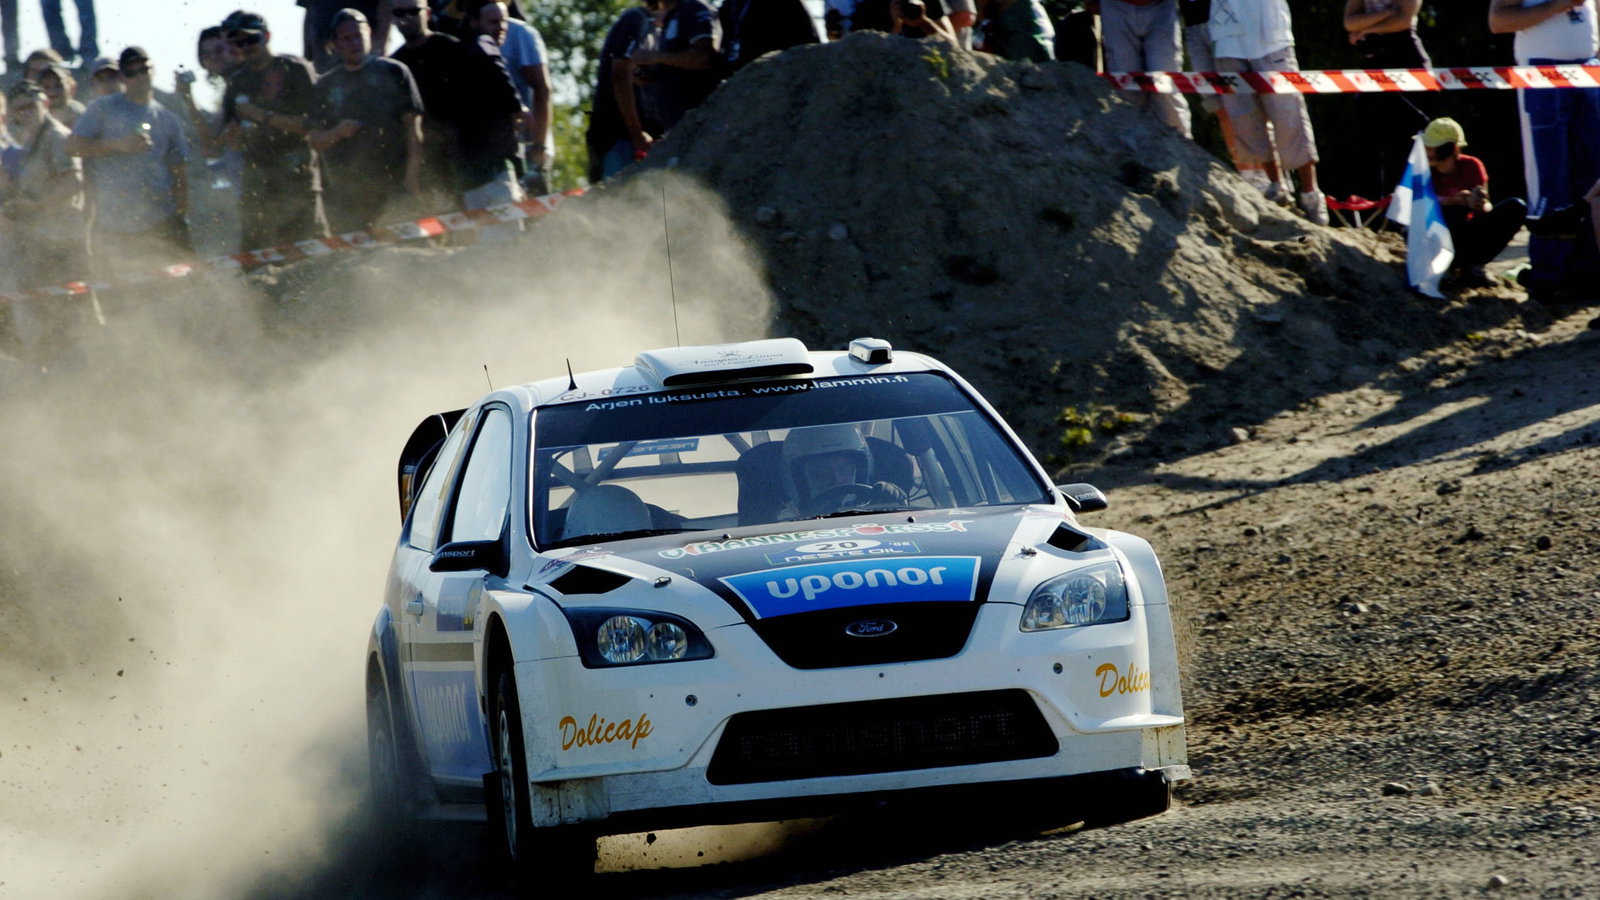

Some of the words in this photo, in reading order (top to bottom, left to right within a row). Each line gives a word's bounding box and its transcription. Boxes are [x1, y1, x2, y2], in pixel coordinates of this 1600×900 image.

[585, 399, 642, 412] Arjen
[649, 389, 746, 404] luksusta.
[752, 375, 909, 394] www.lammin.fi
[784, 551, 865, 562] NESTE
[869, 547, 904, 555] OIL
[815, 541, 858, 551] 20
[766, 566, 947, 601] uponor
[858, 622, 884, 633] Ford
[559, 712, 655, 751] Dolicap
